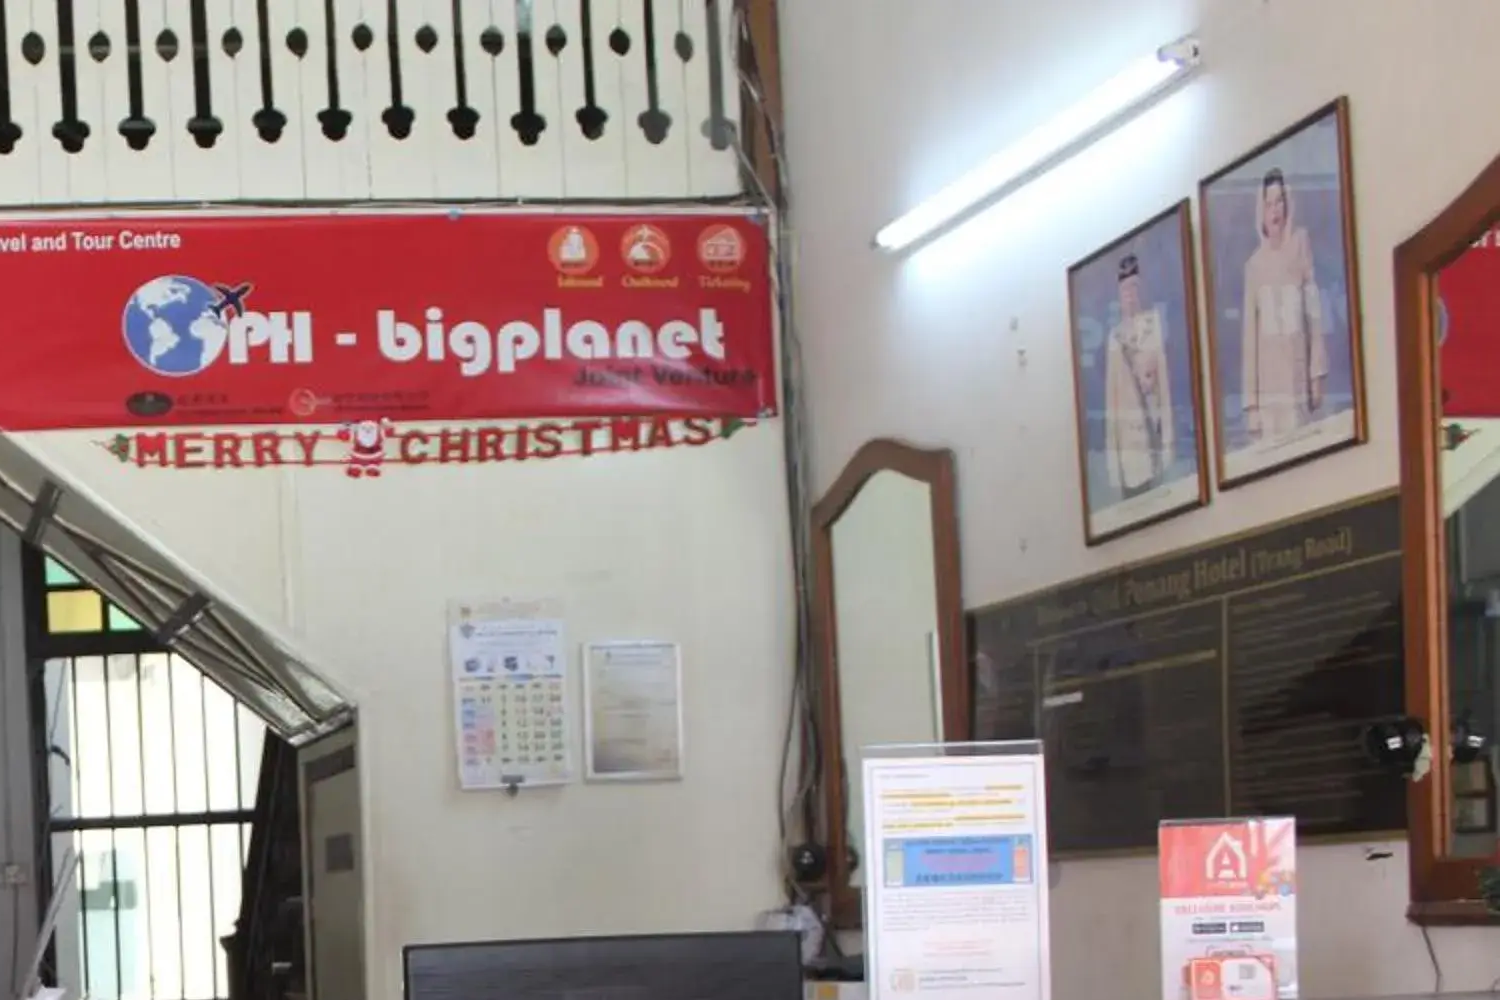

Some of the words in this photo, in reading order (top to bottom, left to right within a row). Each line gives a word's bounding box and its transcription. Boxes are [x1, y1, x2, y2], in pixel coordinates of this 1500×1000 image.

[31, 232, 67, 251] and
[71, 231, 114, 250] Tour
[118, 229, 182, 249] Centre
[376, 306, 725, 377] bigplanet
[573, 365, 642, 388] Joint
[652, 366, 758, 387] Venture
[134, 430, 321, 468] MERRY
[399, 415, 714, 465] CHRISTMAS
[1193, 548, 1247, 589] Hotel
